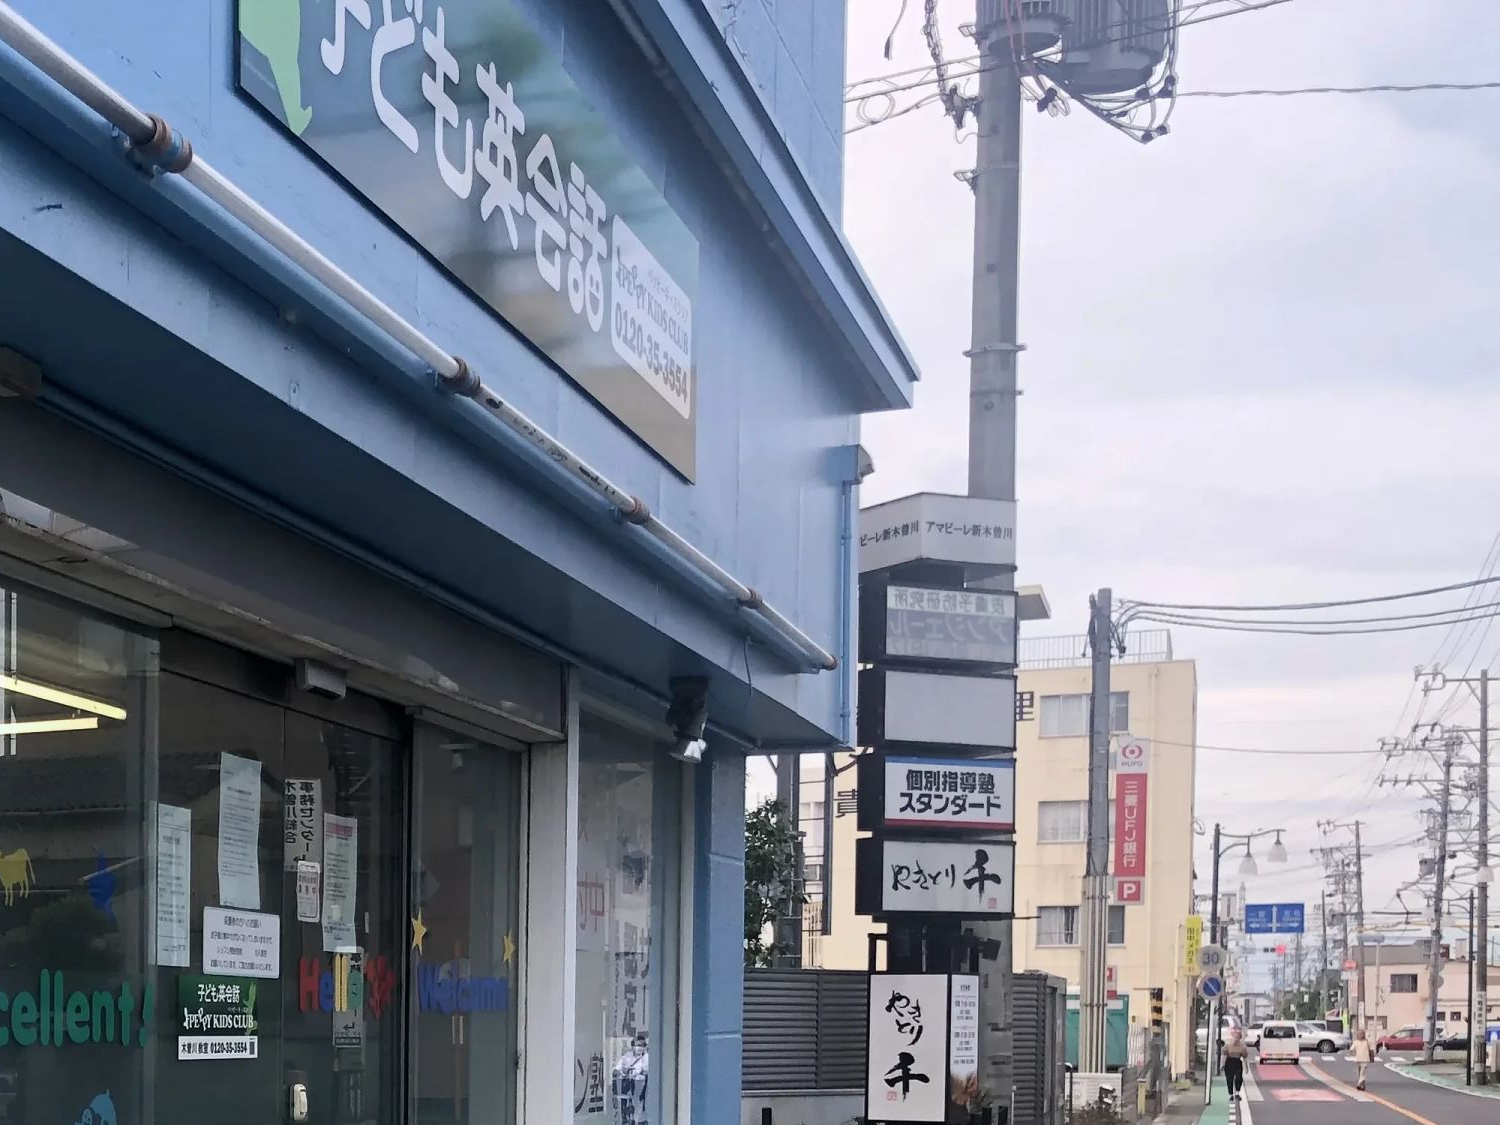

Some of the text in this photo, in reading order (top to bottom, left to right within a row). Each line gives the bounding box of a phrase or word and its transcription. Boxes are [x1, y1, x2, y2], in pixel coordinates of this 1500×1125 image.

[615, 301, 688, 404] 0120-35-3554
[925, 521, 1013, 540] アマビーレ新木曽川
[906, 769, 995, 794] 個別指導塾
[899, 792, 1001, 817] スタンダード
[891, 849, 1001, 904] やきとり 千
[1123, 882, 1137, 898] P
[1202, 952, 1220, 966] 30
[197, 983, 241, 1004] 子ども英会話
[299, 953, 363, 1013] Hello
[213, 1014, 232, 1029] KIDS
[233, 1014, 254, 1029] CLUB
[210, 1041, 247, 1055] 0120-35-3554
[884, 1052, 930, 1103] 千
